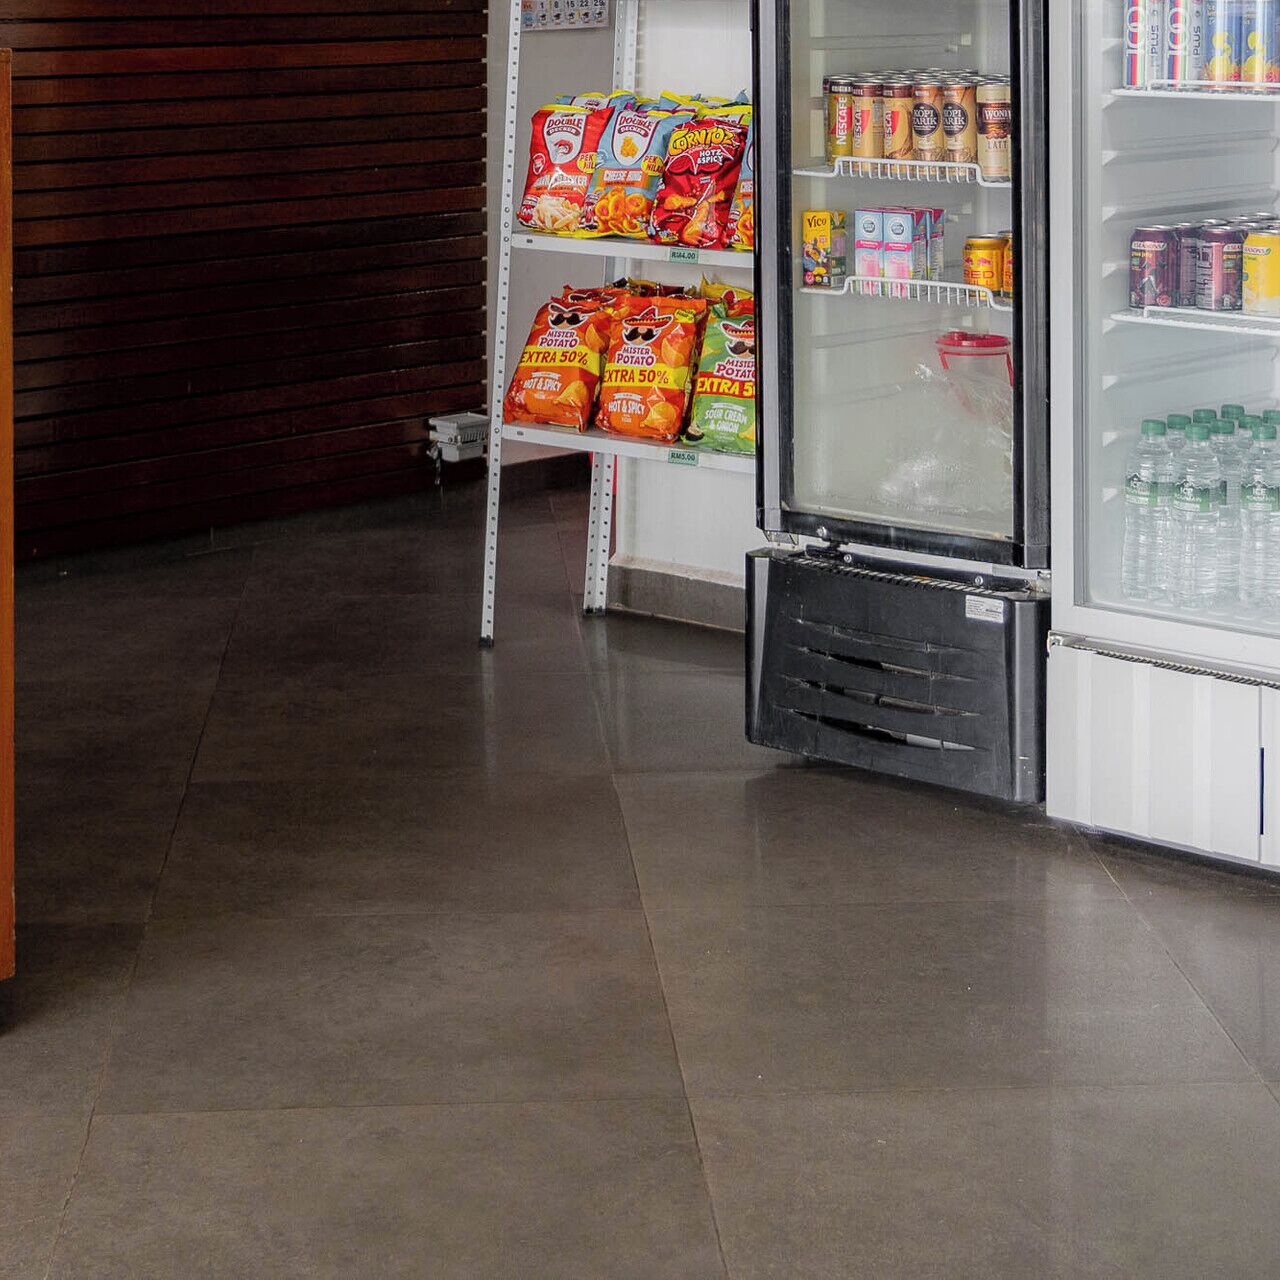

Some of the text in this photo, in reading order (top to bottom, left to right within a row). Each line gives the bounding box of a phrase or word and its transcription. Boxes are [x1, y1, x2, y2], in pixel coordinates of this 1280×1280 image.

[566, 0, 575, 8] 15
[1150, 24, 1160, 55] PLUS
[1193, 25, 1201, 56] PLUS
[547, 118, 582, 129] DOUBLE
[620, 116, 653, 130] DOUBLE
[670, 127, 735, 156] CORNTOZ
[671, 251, 696, 260] RM4.00
[547, 330, 575, 338] MISTER
[539, 337, 578, 348] POTATO
[521, 351, 588, 365] EXTRA 50%
[622, 347, 651, 355] MISTER
[616, 353, 656, 367] POTATO
[637, 369, 669, 384] 50%
[523, 378, 536, 389] HOT
[542, 380, 561, 392] SPICY
[697, 377, 740, 395] EXTRA
[608, 401, 621, 412] HOT
[628, 401, 645, 415] SPICY
[705, 409, 723, 420] SOUR
[671, 452, 695, 462] RM5.00
